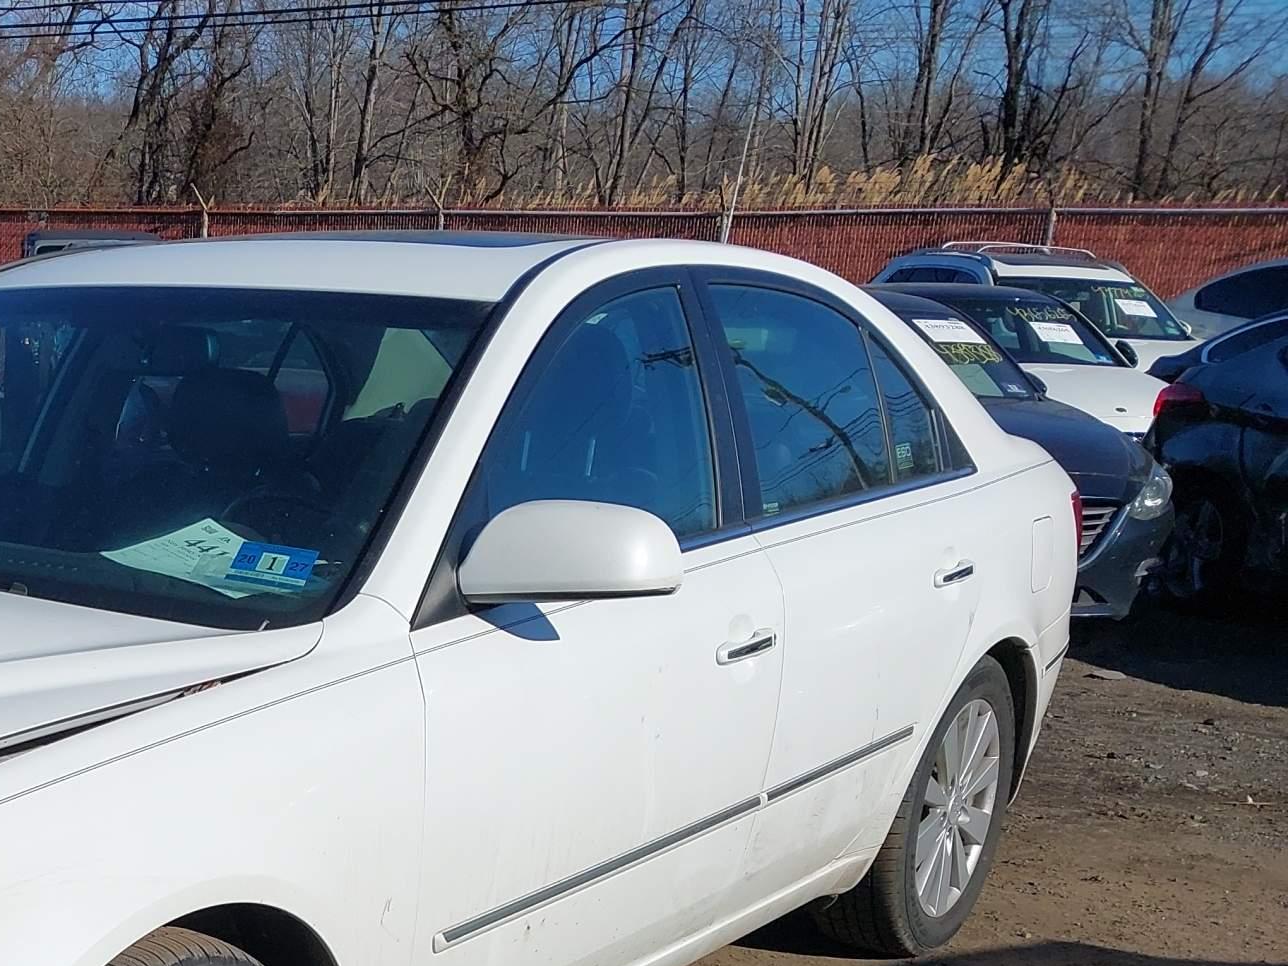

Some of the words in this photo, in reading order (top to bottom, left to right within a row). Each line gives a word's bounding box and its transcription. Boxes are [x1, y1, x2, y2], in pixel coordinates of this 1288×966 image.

[238, 554, 256, 565] 20
[267, 556, 277, 571] 1
[289, 562, 309, 573] 27
